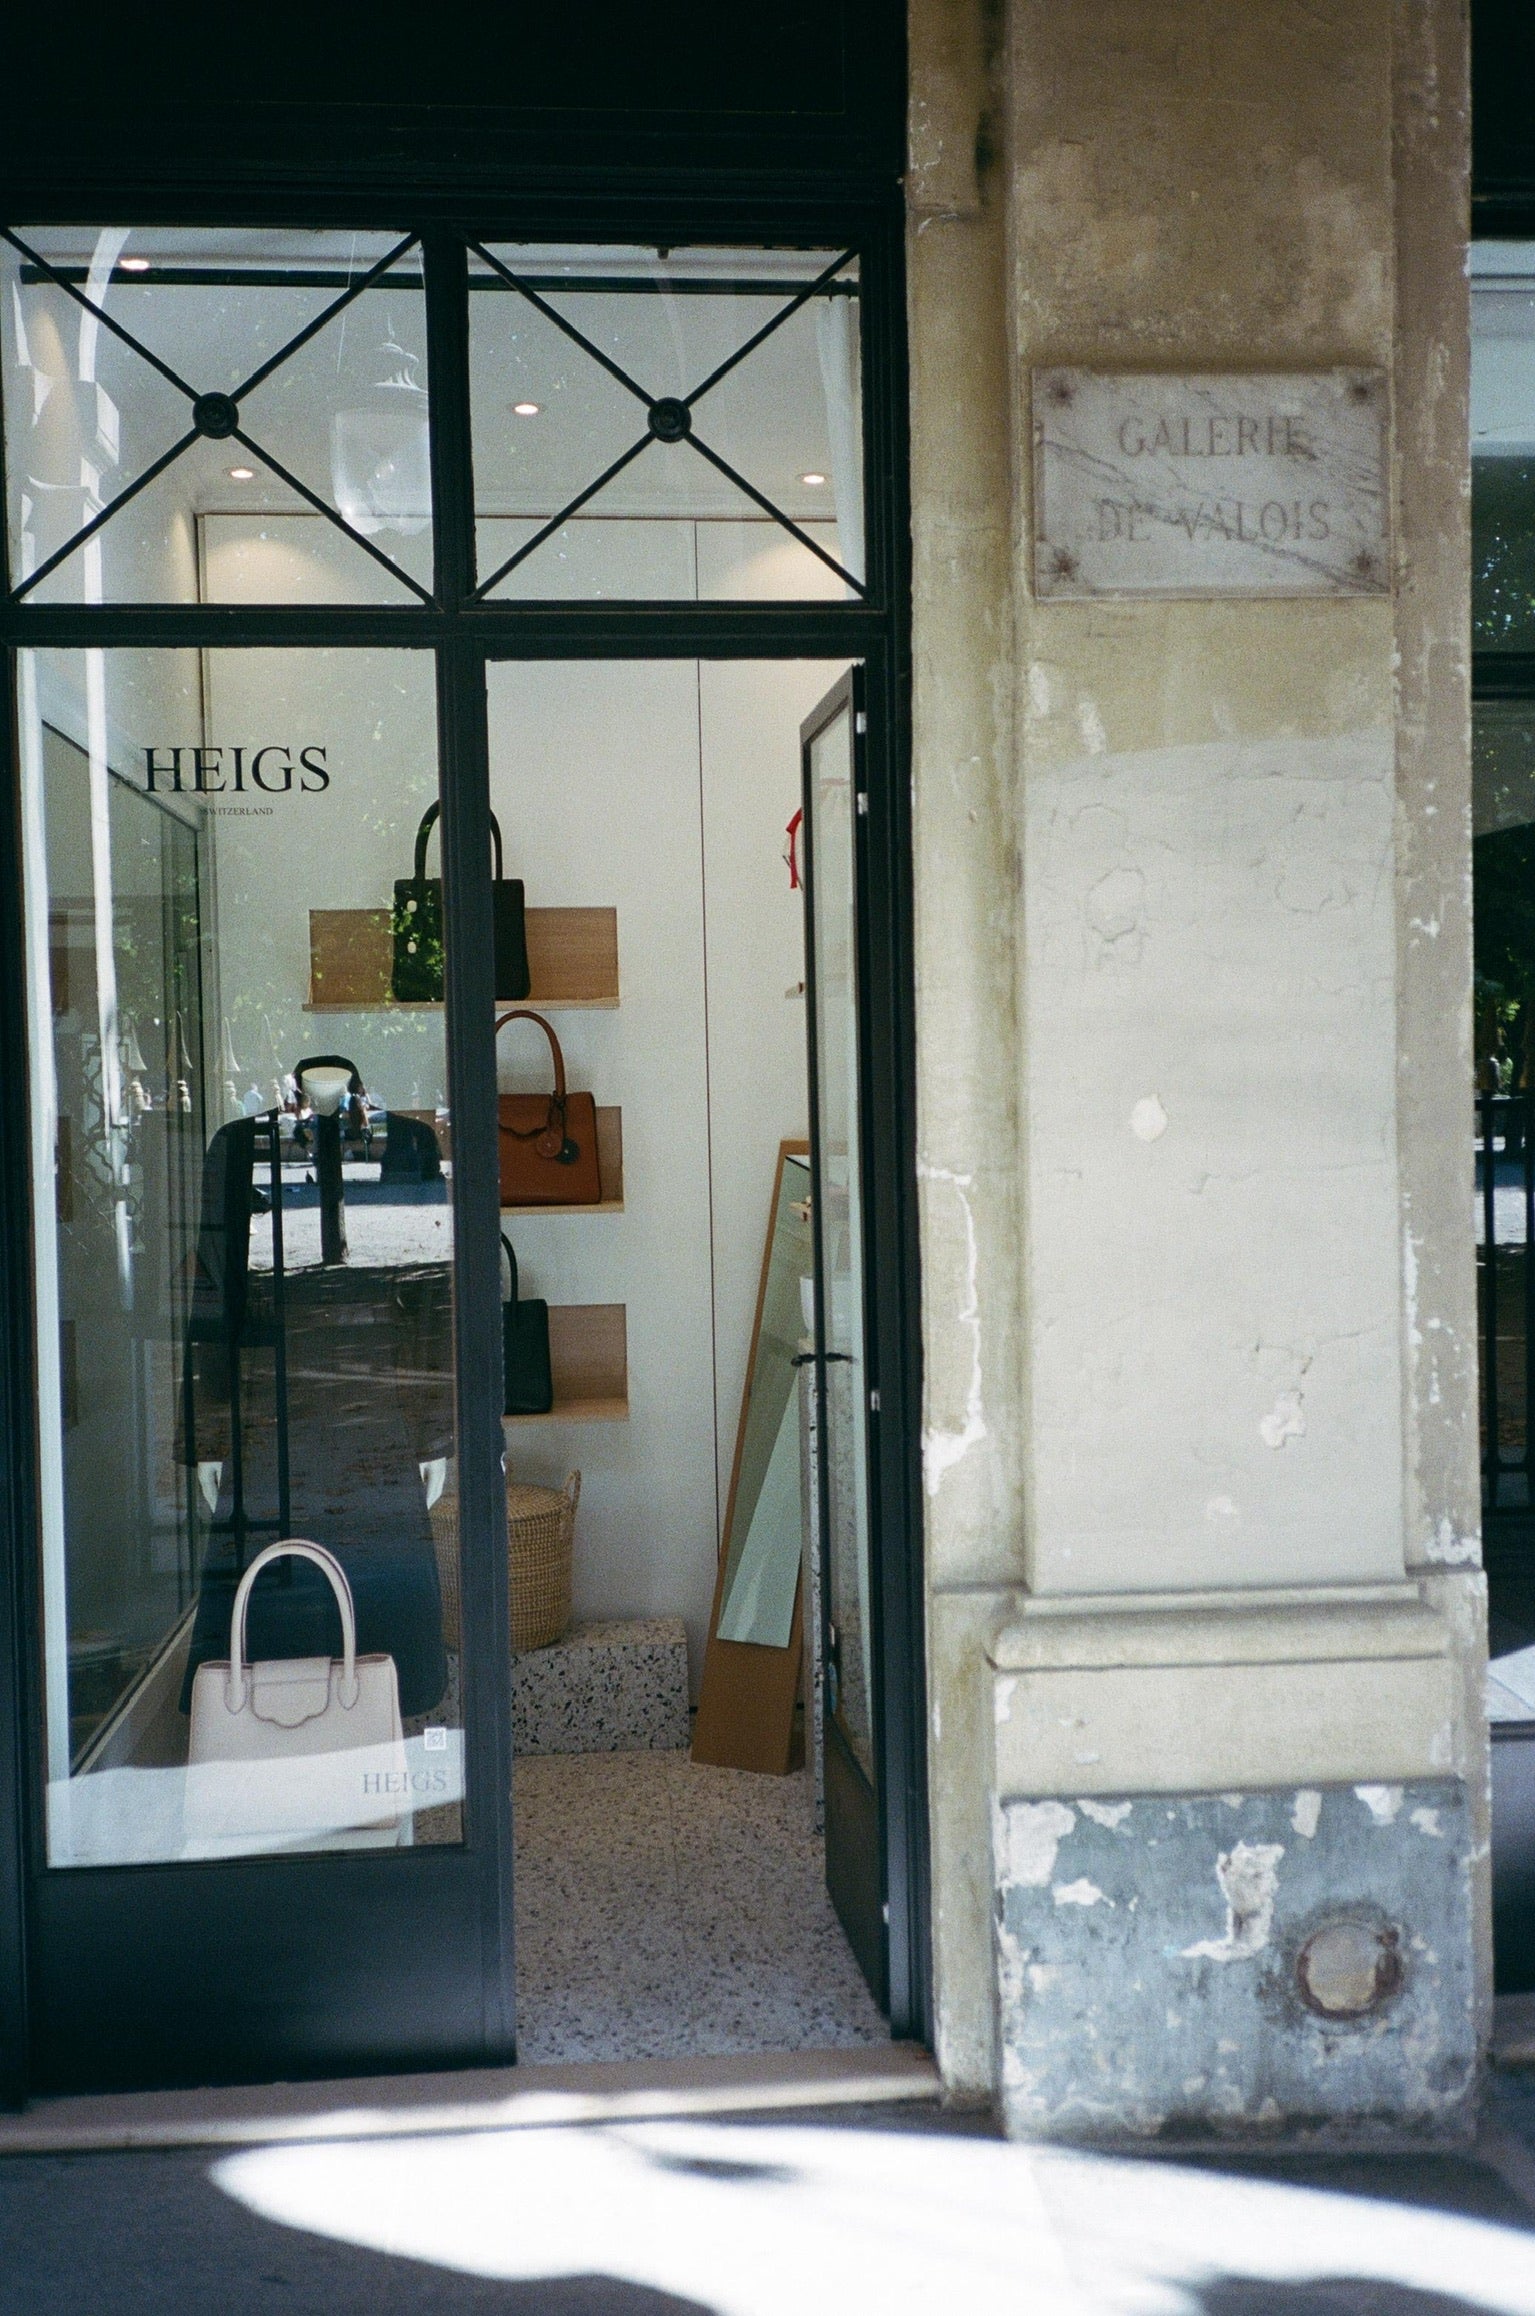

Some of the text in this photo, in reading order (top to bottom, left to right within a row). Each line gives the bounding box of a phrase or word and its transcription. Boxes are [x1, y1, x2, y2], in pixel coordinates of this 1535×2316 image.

[1117, 415, 1306, 457] GALERIE
[1097, 501, 1331, 541] DE VALOIS
[141, 746, 330, 792] HEIGS
[203, 807, 274, 816] SWITZERLAND
[364, 1770, 447, 1793] HEIGS
